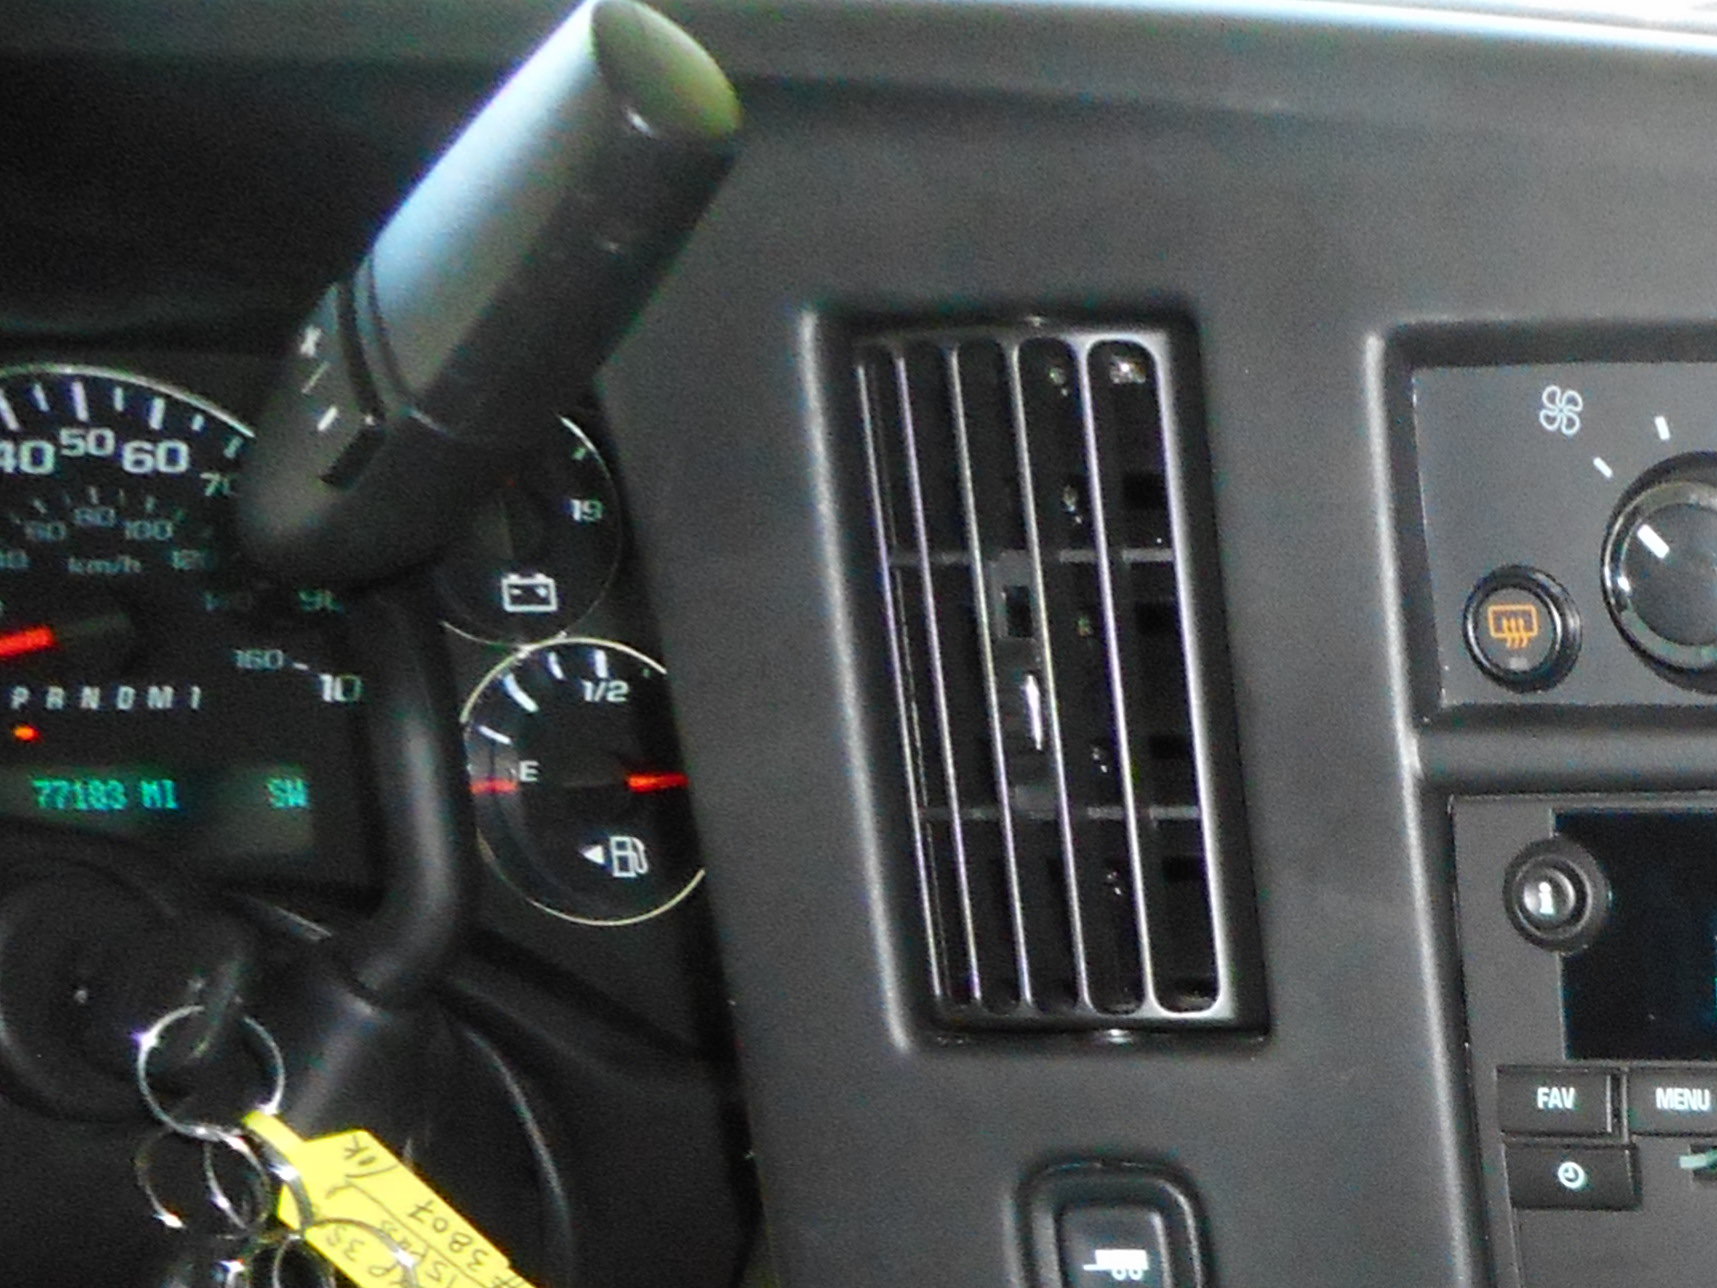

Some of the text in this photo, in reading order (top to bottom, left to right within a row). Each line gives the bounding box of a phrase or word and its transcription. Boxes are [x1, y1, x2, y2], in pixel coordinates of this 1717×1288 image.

[59, 426, 115, 457] 50
[122, 439, 190, 474] 60
[569, 499, 603, 522] 19
[581, 680, 630, 702] 1/2
[519, 761, 541, 782] E
[32, 779, 128, 810] 77183
[1537, 1087, 1576, 1110] FAV
[1655, 1087, 1711, 1112] MENU
